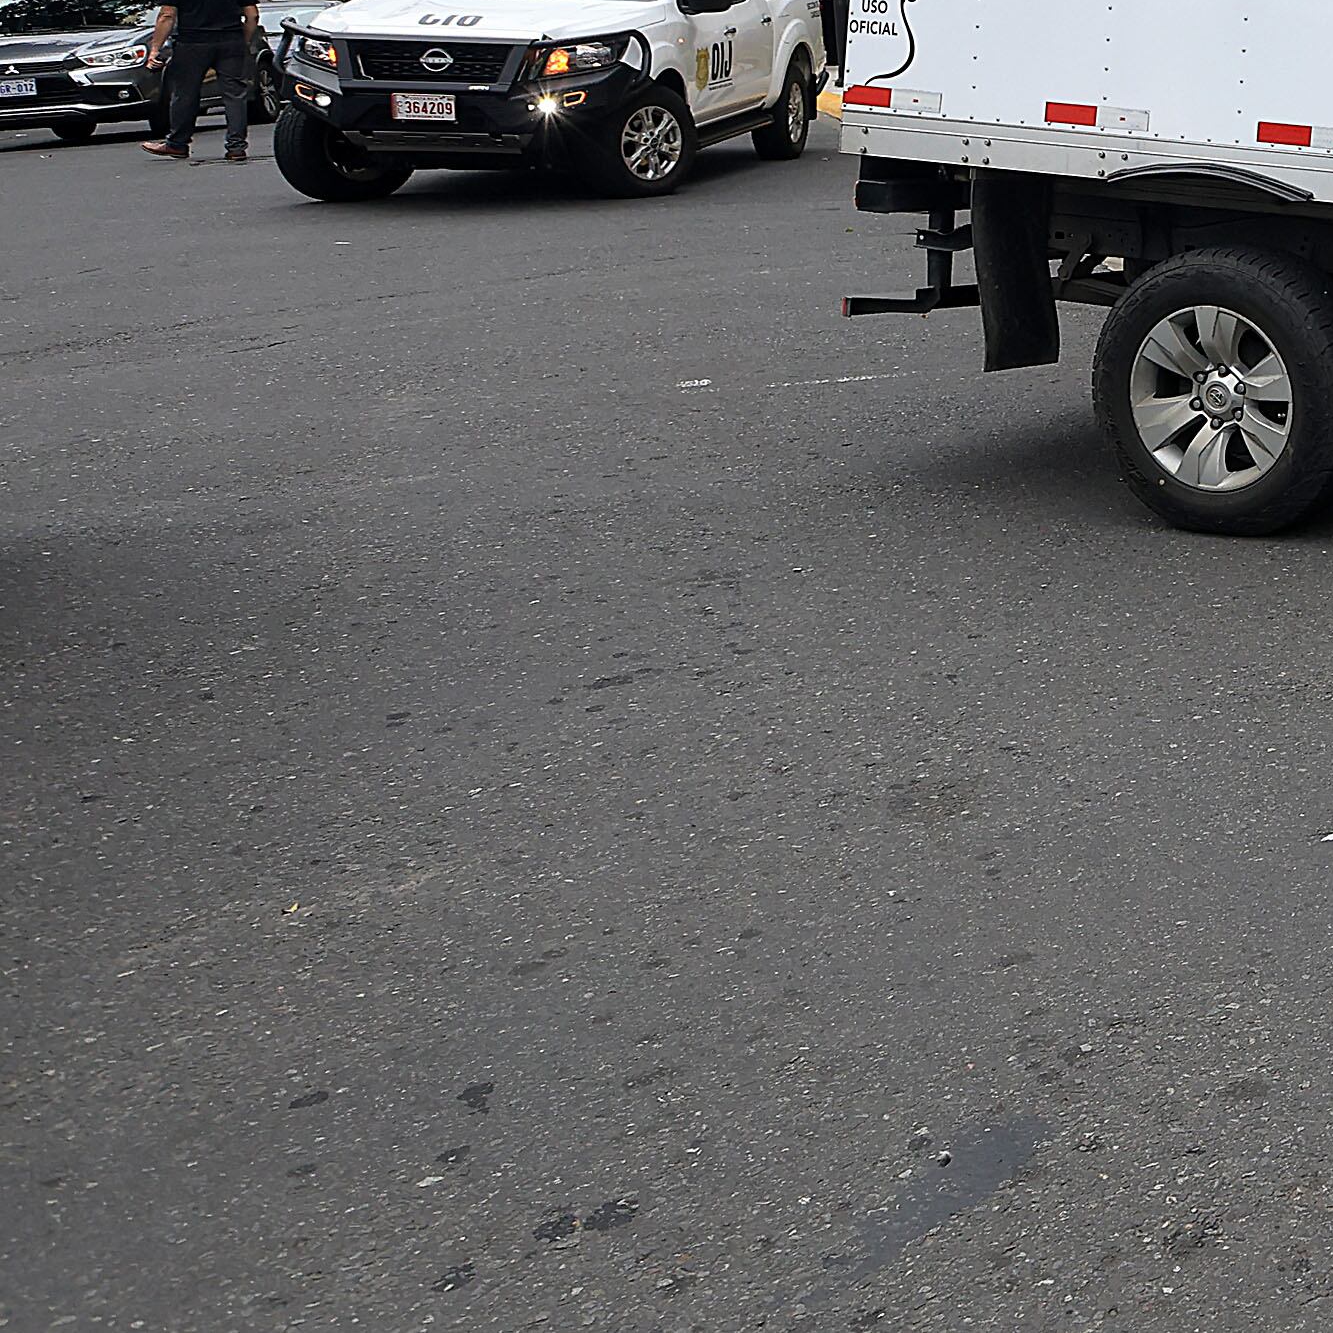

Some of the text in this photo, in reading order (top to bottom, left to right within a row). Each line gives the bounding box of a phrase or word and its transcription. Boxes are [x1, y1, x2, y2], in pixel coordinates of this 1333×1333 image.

[862, 0, 888, 14] USO
[849, 19, 898, 36] OFICIAL
[711, 40, 732, 81] OIJ
[0, 83, 35, 93] GR-012
[405, 101, 453, 115] 364209
